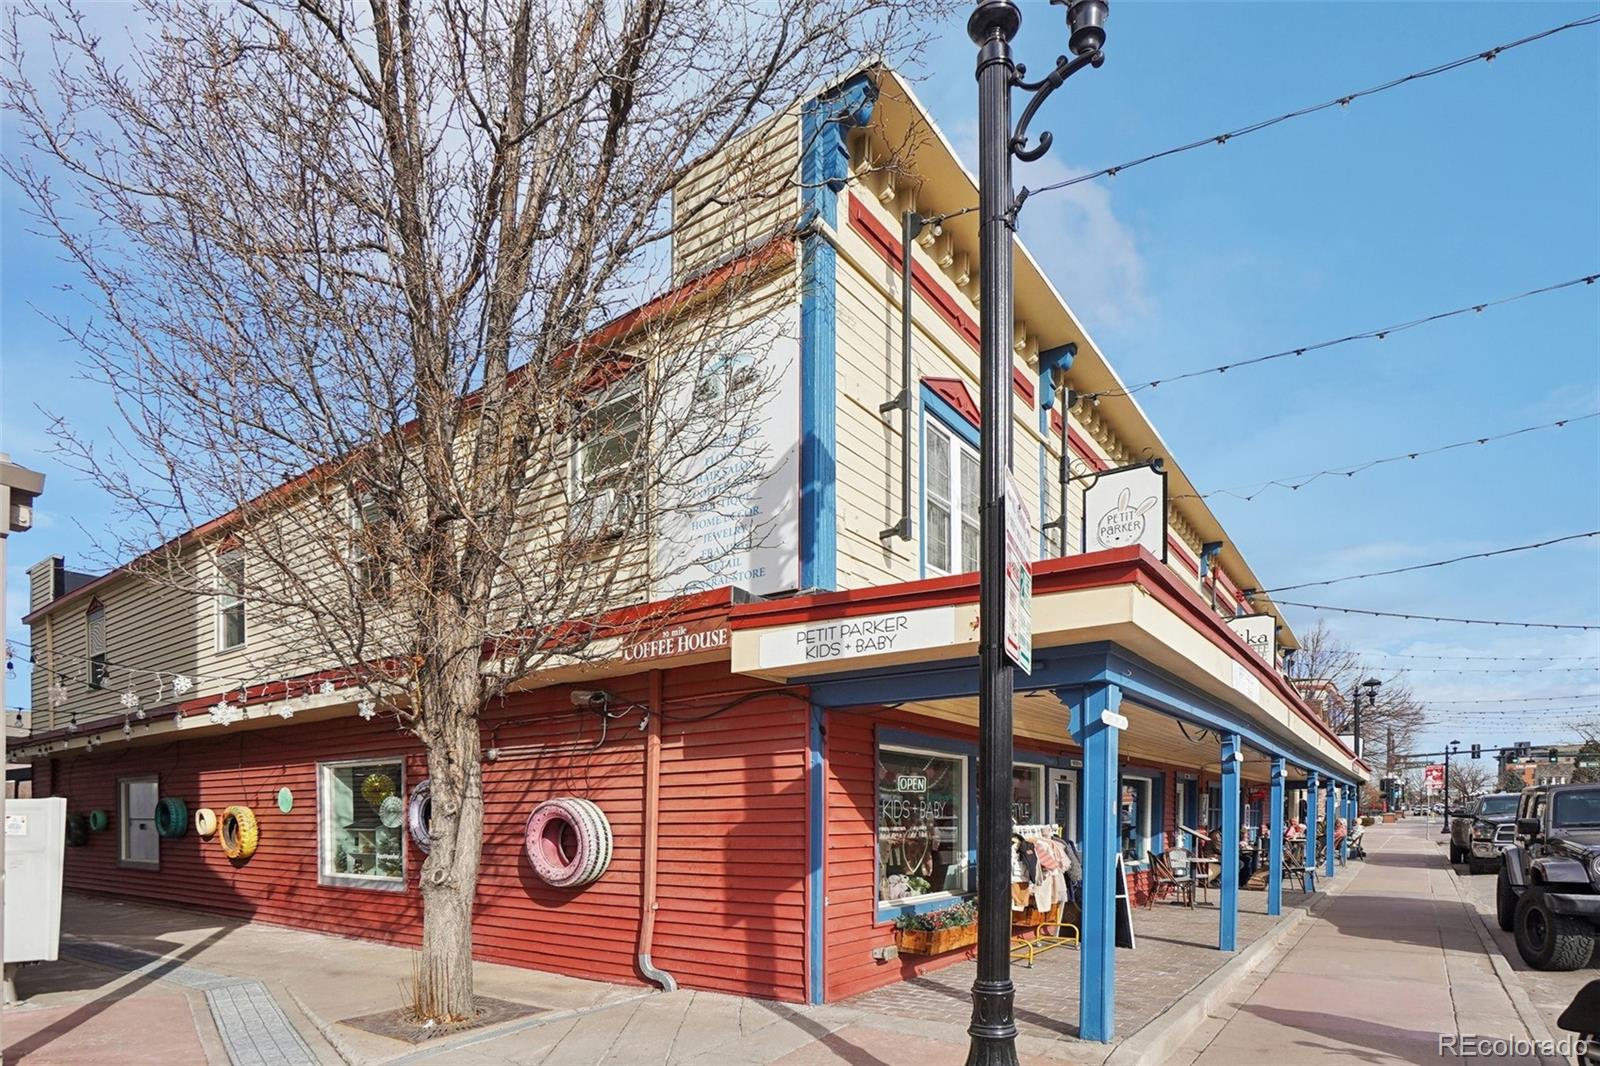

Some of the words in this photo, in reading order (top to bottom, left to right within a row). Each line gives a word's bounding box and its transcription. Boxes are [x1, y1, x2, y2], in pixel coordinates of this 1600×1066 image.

[704, 446, 744, 466] FLOST
[696, 468, 720, 485] HAIR
[691, 516, 720, 531] HOME
[1107, 511, 1134, 525] PETIT
[703, 524, 748, 544] JEWELRY
[707, 557, 742, 573] RETAIL
[728, 566, 766, 583] STORE
[671, 626, 687, 637] mile
[796, 625, 836, 645] PETIT
[840, 615, 909, 638] PARKER
[1240, 629, 1268, 645] ka
[624, 638, 675, 661] COFFEE
[677, 628, 728, 652] HOUSE
[805, 641, 841, 660] KIDS
[855, 634, 898, 653] BABY
[900, 778, 925, 790] OPEN
[882, 800, 911, 818] KIDS
[920, 800, 946, 819] BABY
